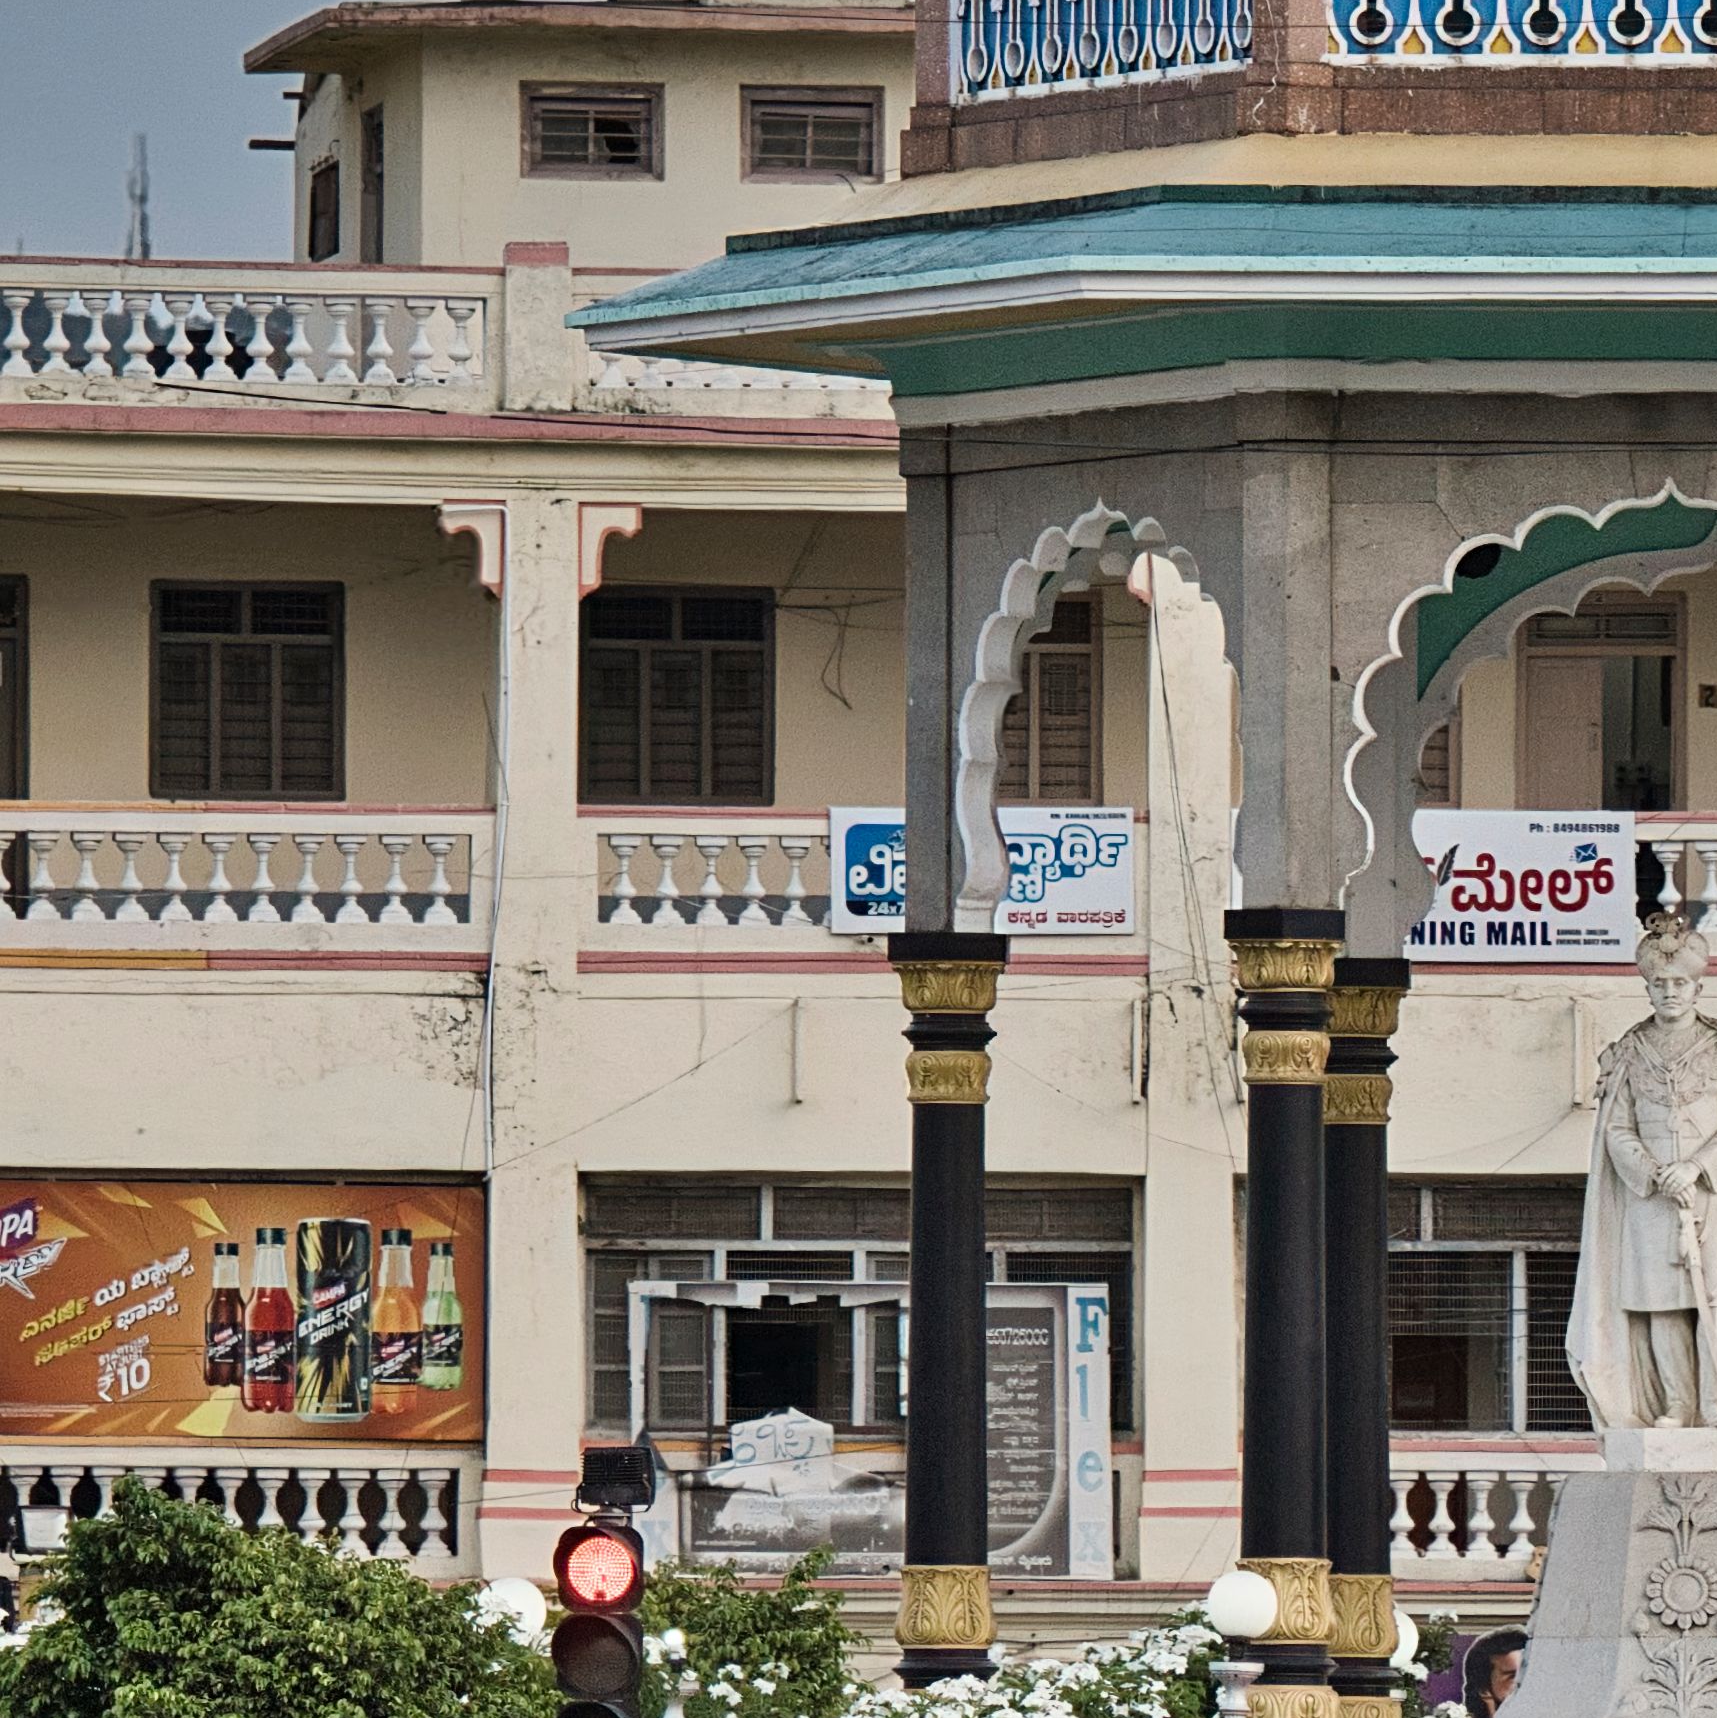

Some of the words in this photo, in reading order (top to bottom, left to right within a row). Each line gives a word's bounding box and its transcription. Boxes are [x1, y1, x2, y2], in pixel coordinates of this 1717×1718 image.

[1530, 823, 1543, 833] Ph
[1451, 853, 1615, 912] ಮೇಲ್
[1007, 910, 1048, 929] ಕನ್ನಡ
[1056, 909, 1126, 928] ವಾರಪತ್ರಿಕೆ
[1411, 921, 1475, 946] NING
[1486, 921, 1552, 946] MAIL
[0, 1209, 34, 1248] PA
[298, 1288, 370, 1339] ENERGY
[310, 1317, 349, 1345] DRINK
